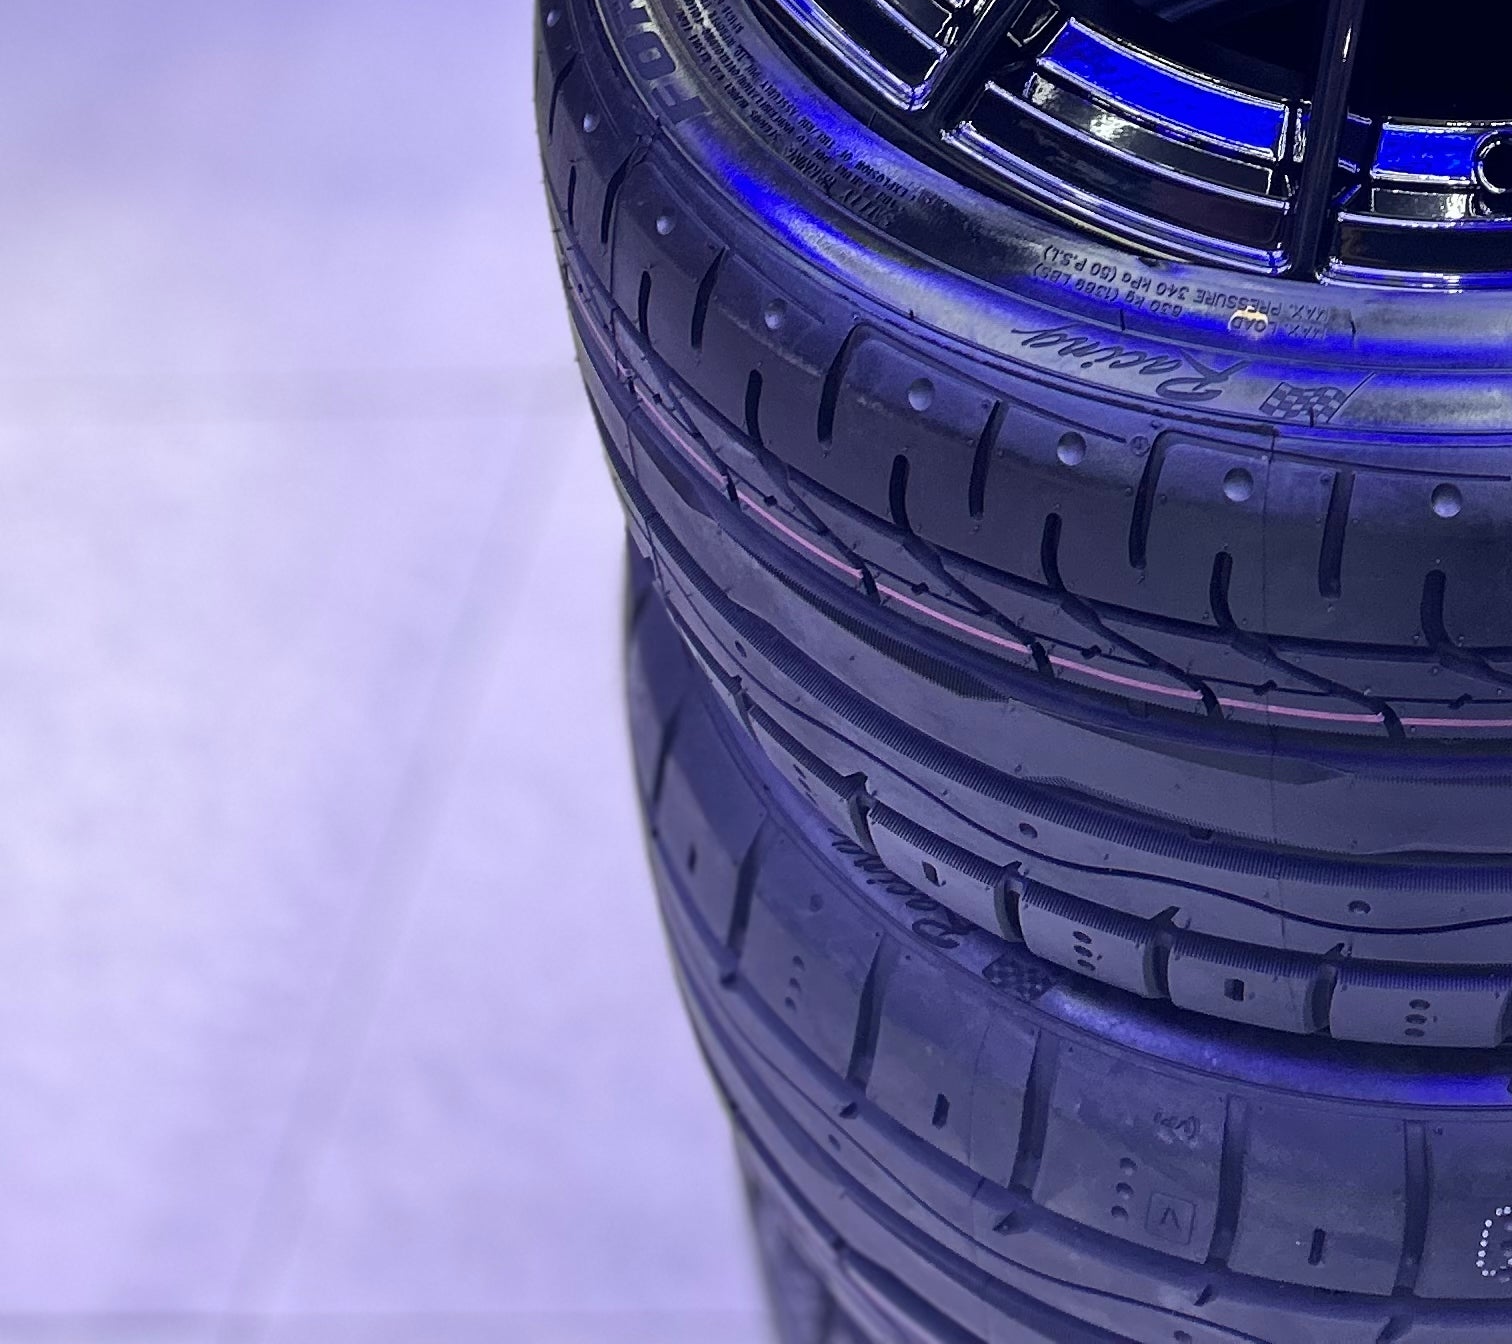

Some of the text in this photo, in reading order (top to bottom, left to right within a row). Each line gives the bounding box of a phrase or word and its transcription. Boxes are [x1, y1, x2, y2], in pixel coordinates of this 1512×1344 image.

[1031, 260, 1072, 287] LBS)
[1119, 270, 1152, 293] kPa
[1123, 288, 1146, 309] kg
[1154, 278, 1190, 301] 340
[1192, 287, 1281, 317] PRESSURE
[1229, 314, 1277, 335] LOAD
[1010, 322, 1248, 403] Racing
